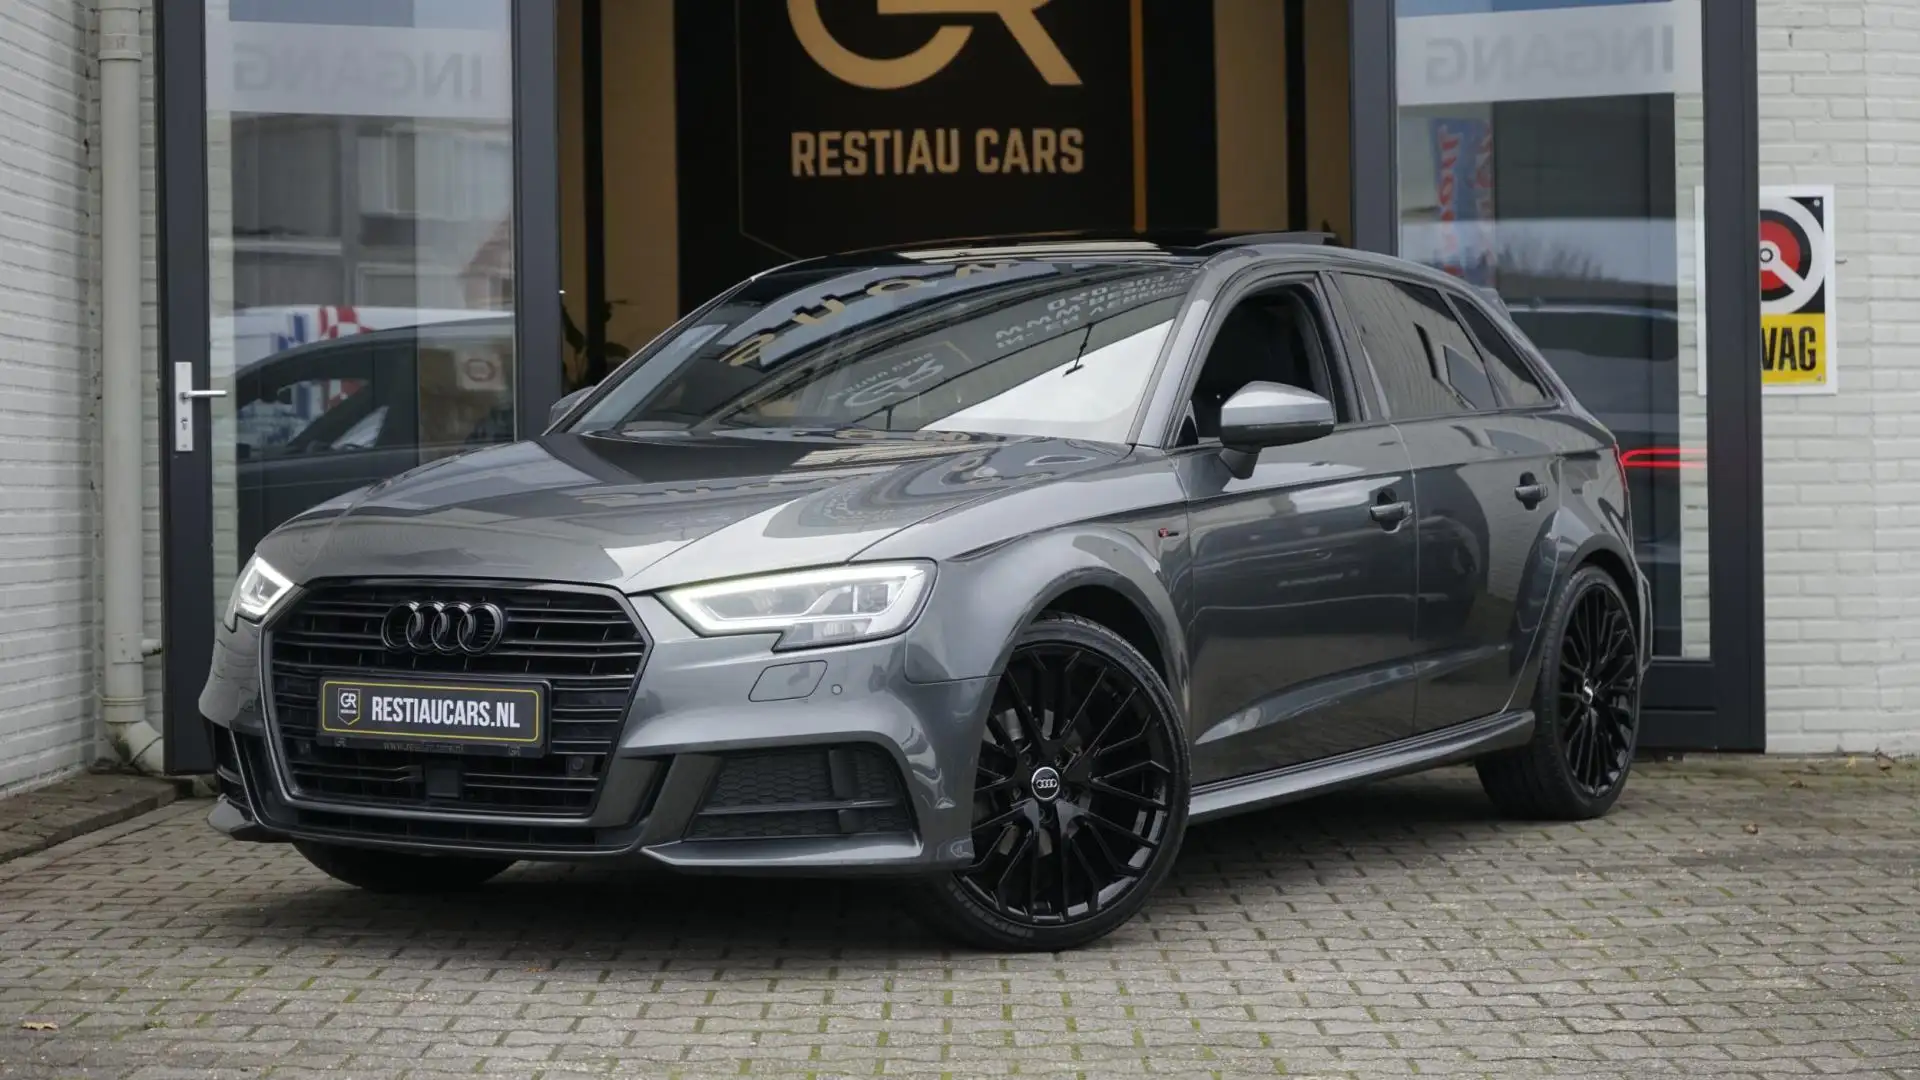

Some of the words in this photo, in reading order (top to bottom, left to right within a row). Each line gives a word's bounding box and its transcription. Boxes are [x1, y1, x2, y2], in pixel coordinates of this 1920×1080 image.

[790, 128, 960, 177] RESTIAU
[975, 127, 1085, 174] CARS
[1761, 326, 1817, 371] VAG
[371, 696, 521, 728] RESTIAUCARS.NL
